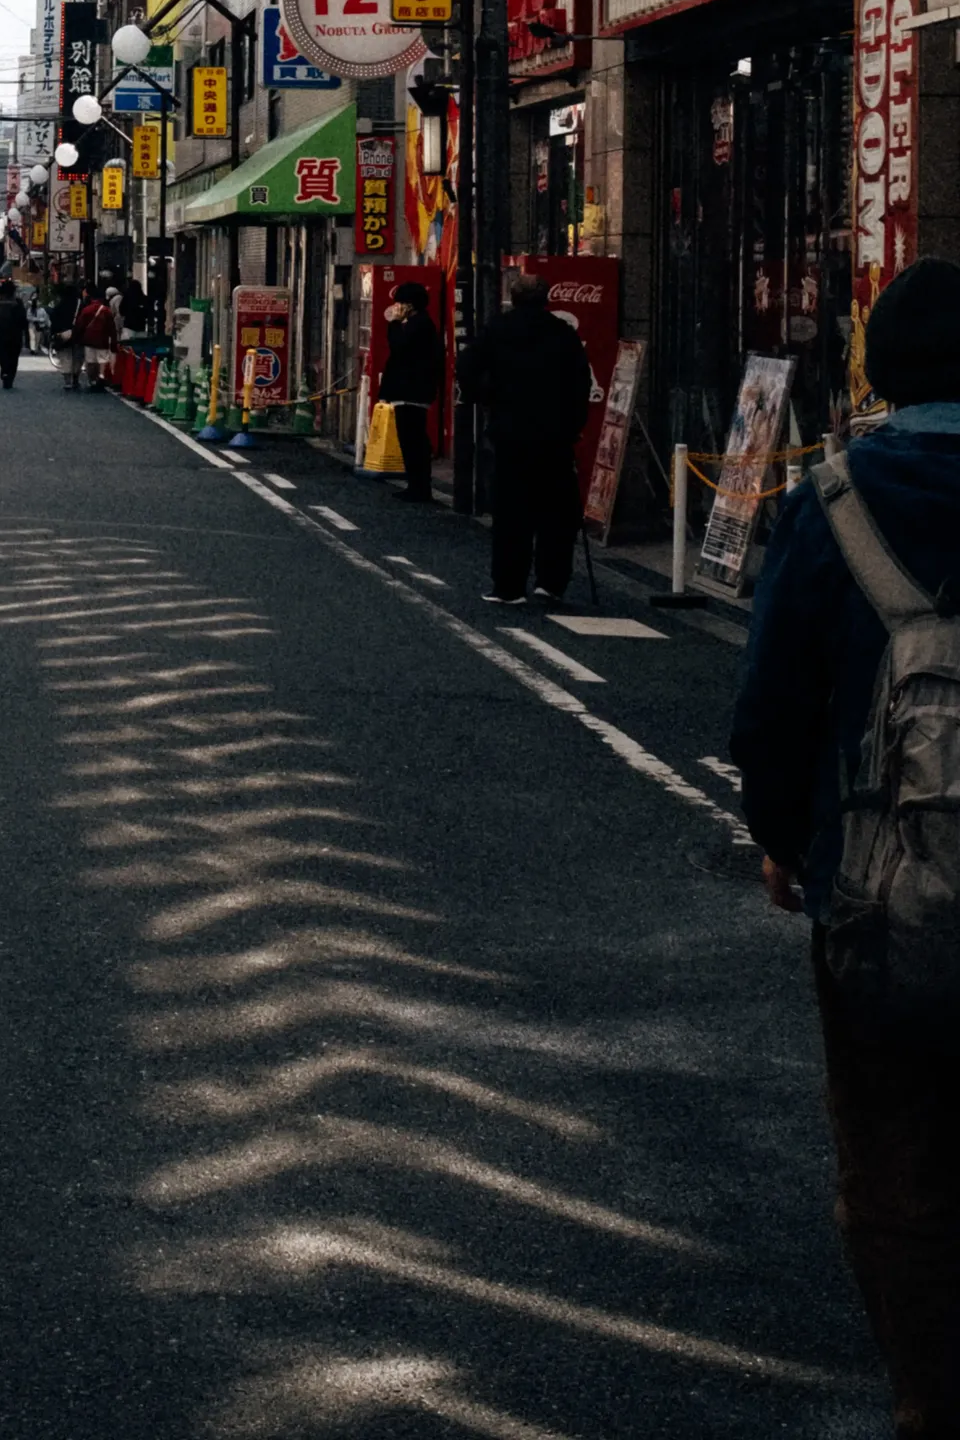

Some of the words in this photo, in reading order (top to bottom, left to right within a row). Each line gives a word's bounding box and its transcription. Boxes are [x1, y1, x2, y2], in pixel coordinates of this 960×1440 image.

[398, 6, 446, 17] 商店街
[315, 24, 366, 37] NOBUTA
[69, 40, 93, 94] 別館
[203, 78, 217, 125] 中央通り
[140, 134, 151, 169] 中央通り
[359, 150, 393, 165] iPhone
[294, 157, 341, 205] 質
[361, 166, 392, 177] iPad
[363, 179, 387, 249] 質預かり
